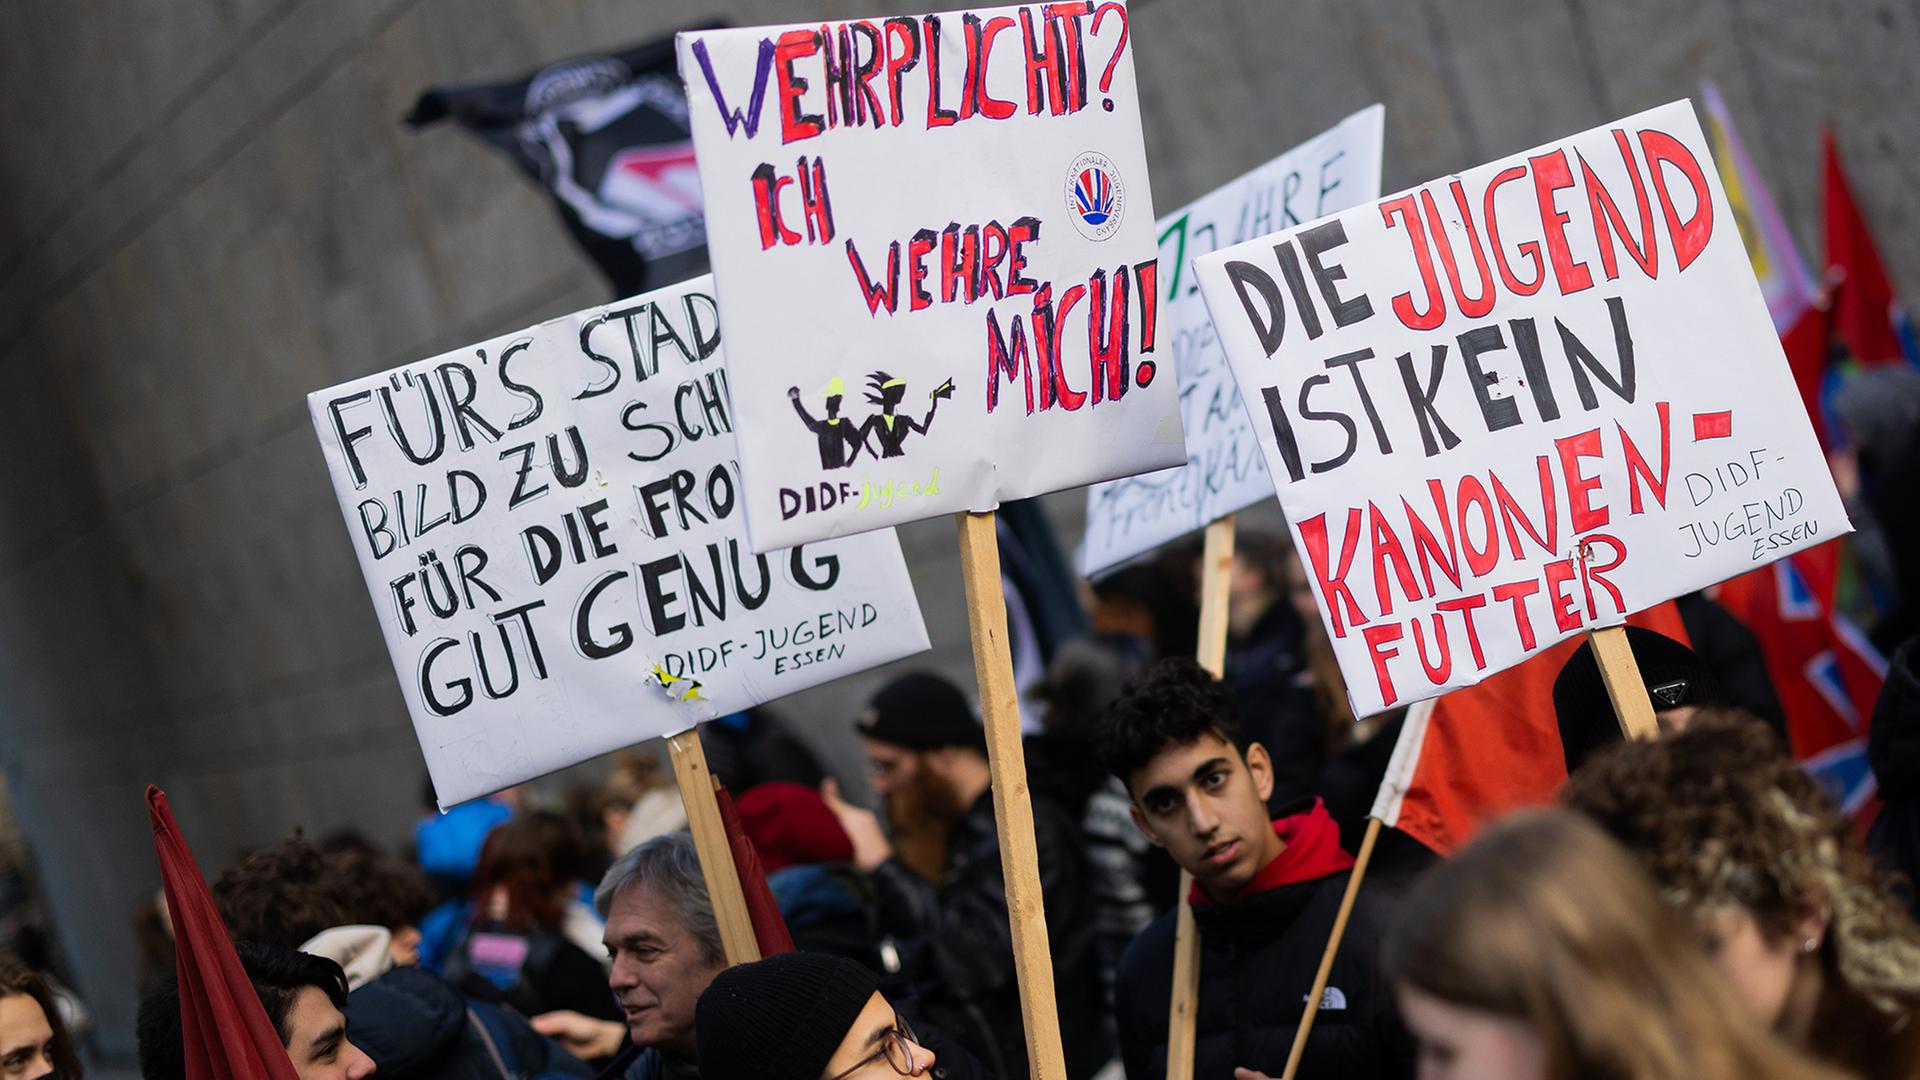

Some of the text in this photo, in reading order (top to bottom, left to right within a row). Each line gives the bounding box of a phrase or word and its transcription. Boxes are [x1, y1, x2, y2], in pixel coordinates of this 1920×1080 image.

[692, 1, 1128, 144] WEHRPLICHT?
[845, 216, 1042, 318] WEHRE
[1224, 129, 1713, 358] DIE JUGEND
[328, 293, 722, 490] FÜR'S STAD
[359, 367, 734, 559] BILD ZU SCH
[1260, 297, 1635, 483] IST KEIN
[390, 460, 743, 637] FÜR DIE FRO
[1299, 401, 1732, 638] KANONEN-
[1679, 488, 1803, 557] JUGEND
[1685, 448, 1784, 507] DIDF-
[1752, 520, 1818, 560] ESSEN
[416, 537, 841, 717] GUT GENUG
[664, 603, 878, 679] DIDF-JUGEND
[774, 644, 846, 675] ESSEN
[1364, 534, 1627, 707] FUTTER
